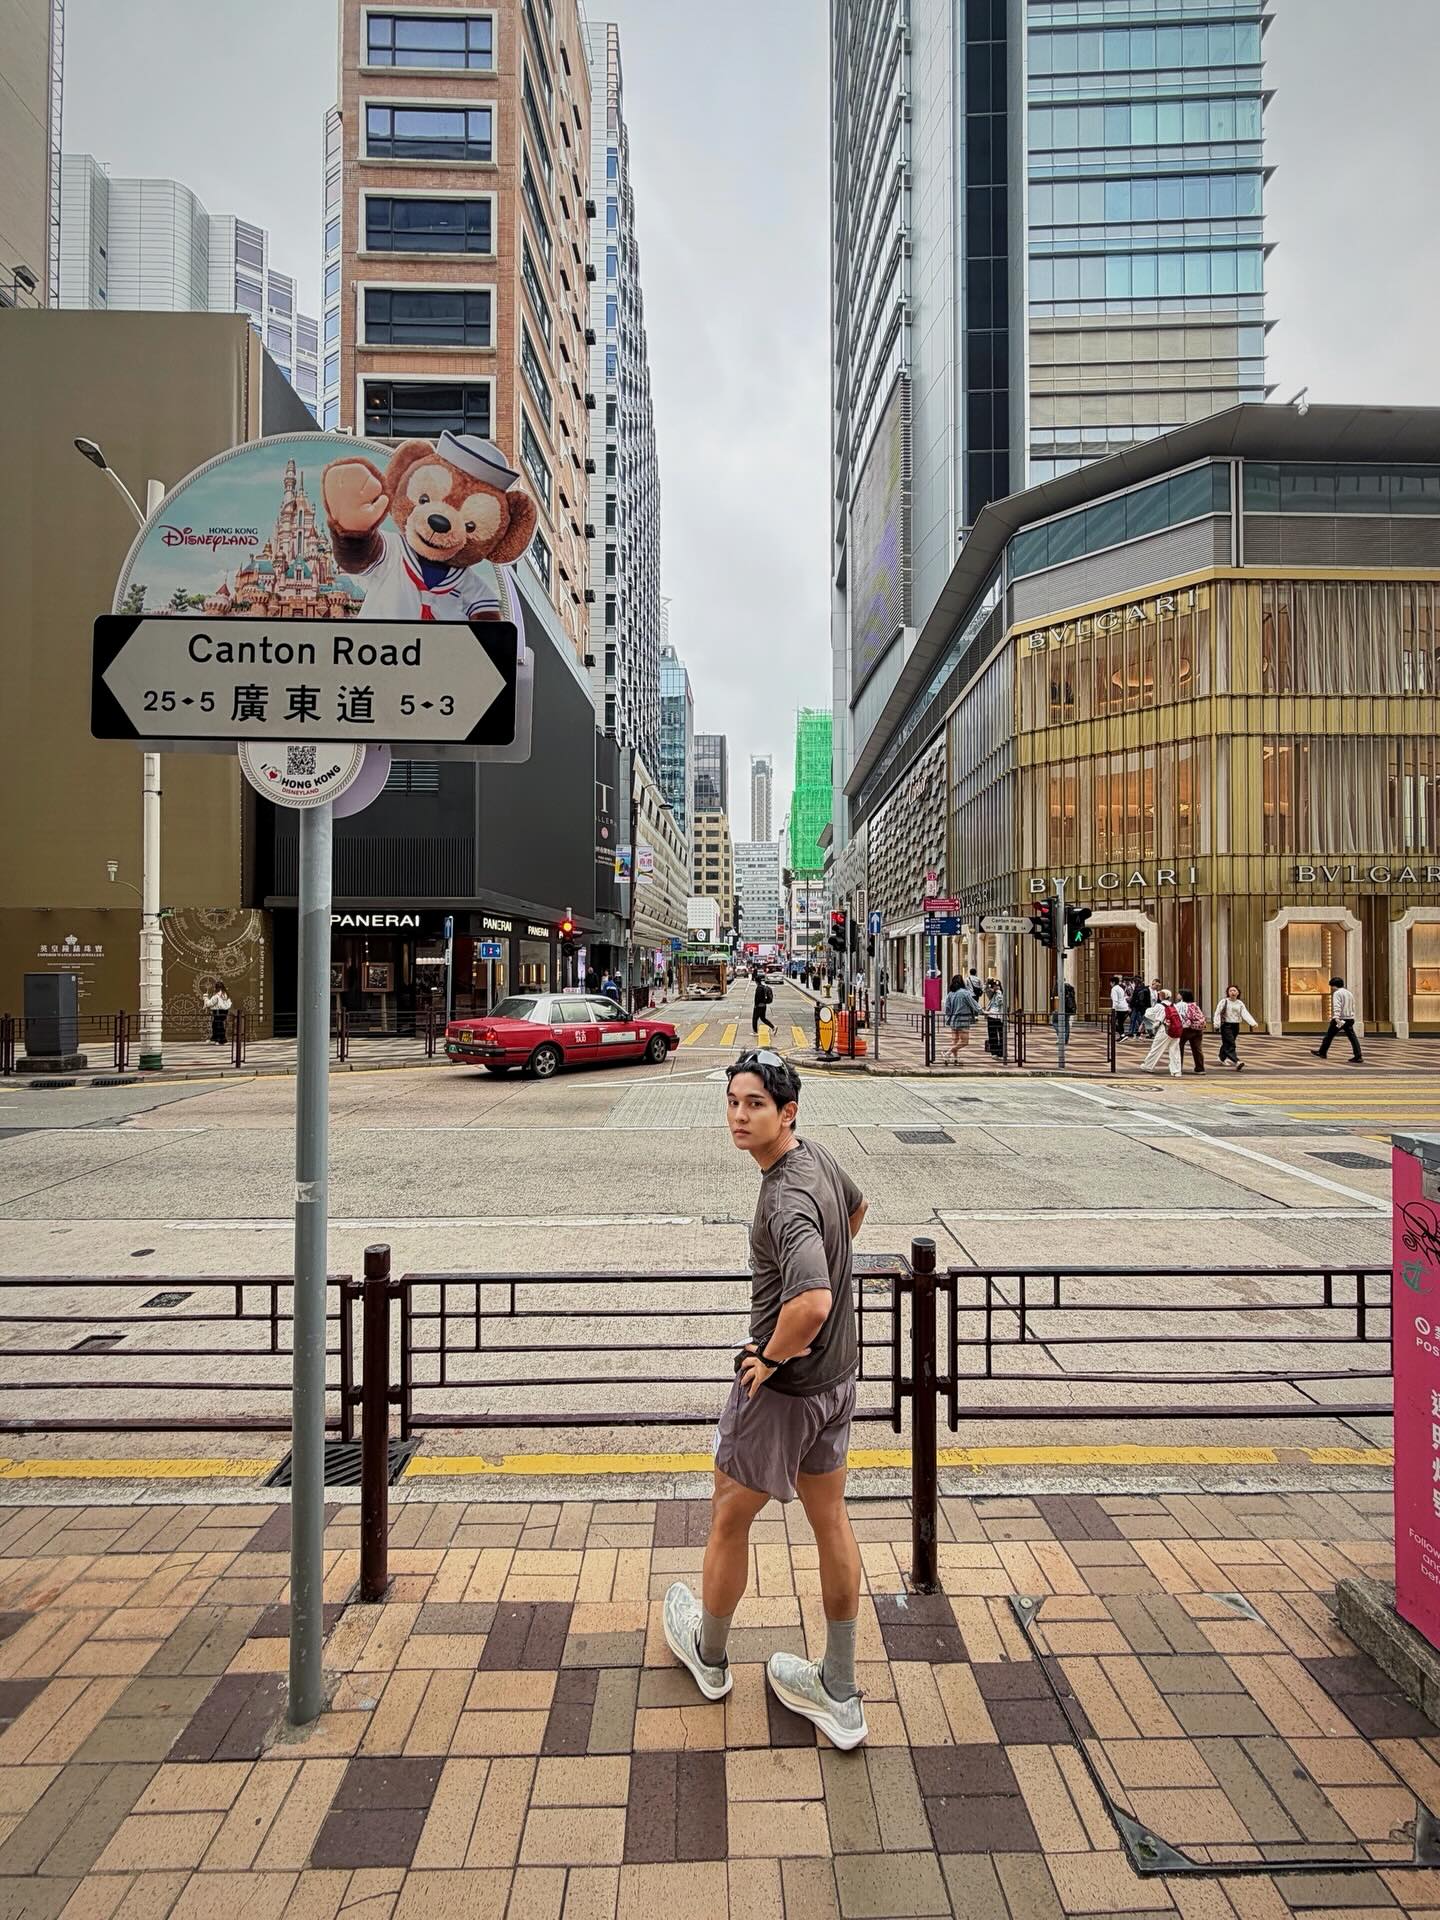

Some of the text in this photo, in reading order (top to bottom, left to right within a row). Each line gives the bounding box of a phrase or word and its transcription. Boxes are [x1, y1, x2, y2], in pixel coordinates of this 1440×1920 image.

[208, 527, 259, 535] HONG KONG
[1027, 588, 1197, 651] BVLGARI
[187, 632, 422, 667] Canton Road
[230, 682, 376, 724] 廣東道
[281, 777, 312, 790] HONG
[313, 764, 341, 787] KONG
[281, 786, 320, 797] DISNEYLAND
[329, 914, 421, 928] PANERAI
[482, 917, 513, 933] PANERAI
[527, 925, 549, 938] PANERAI
